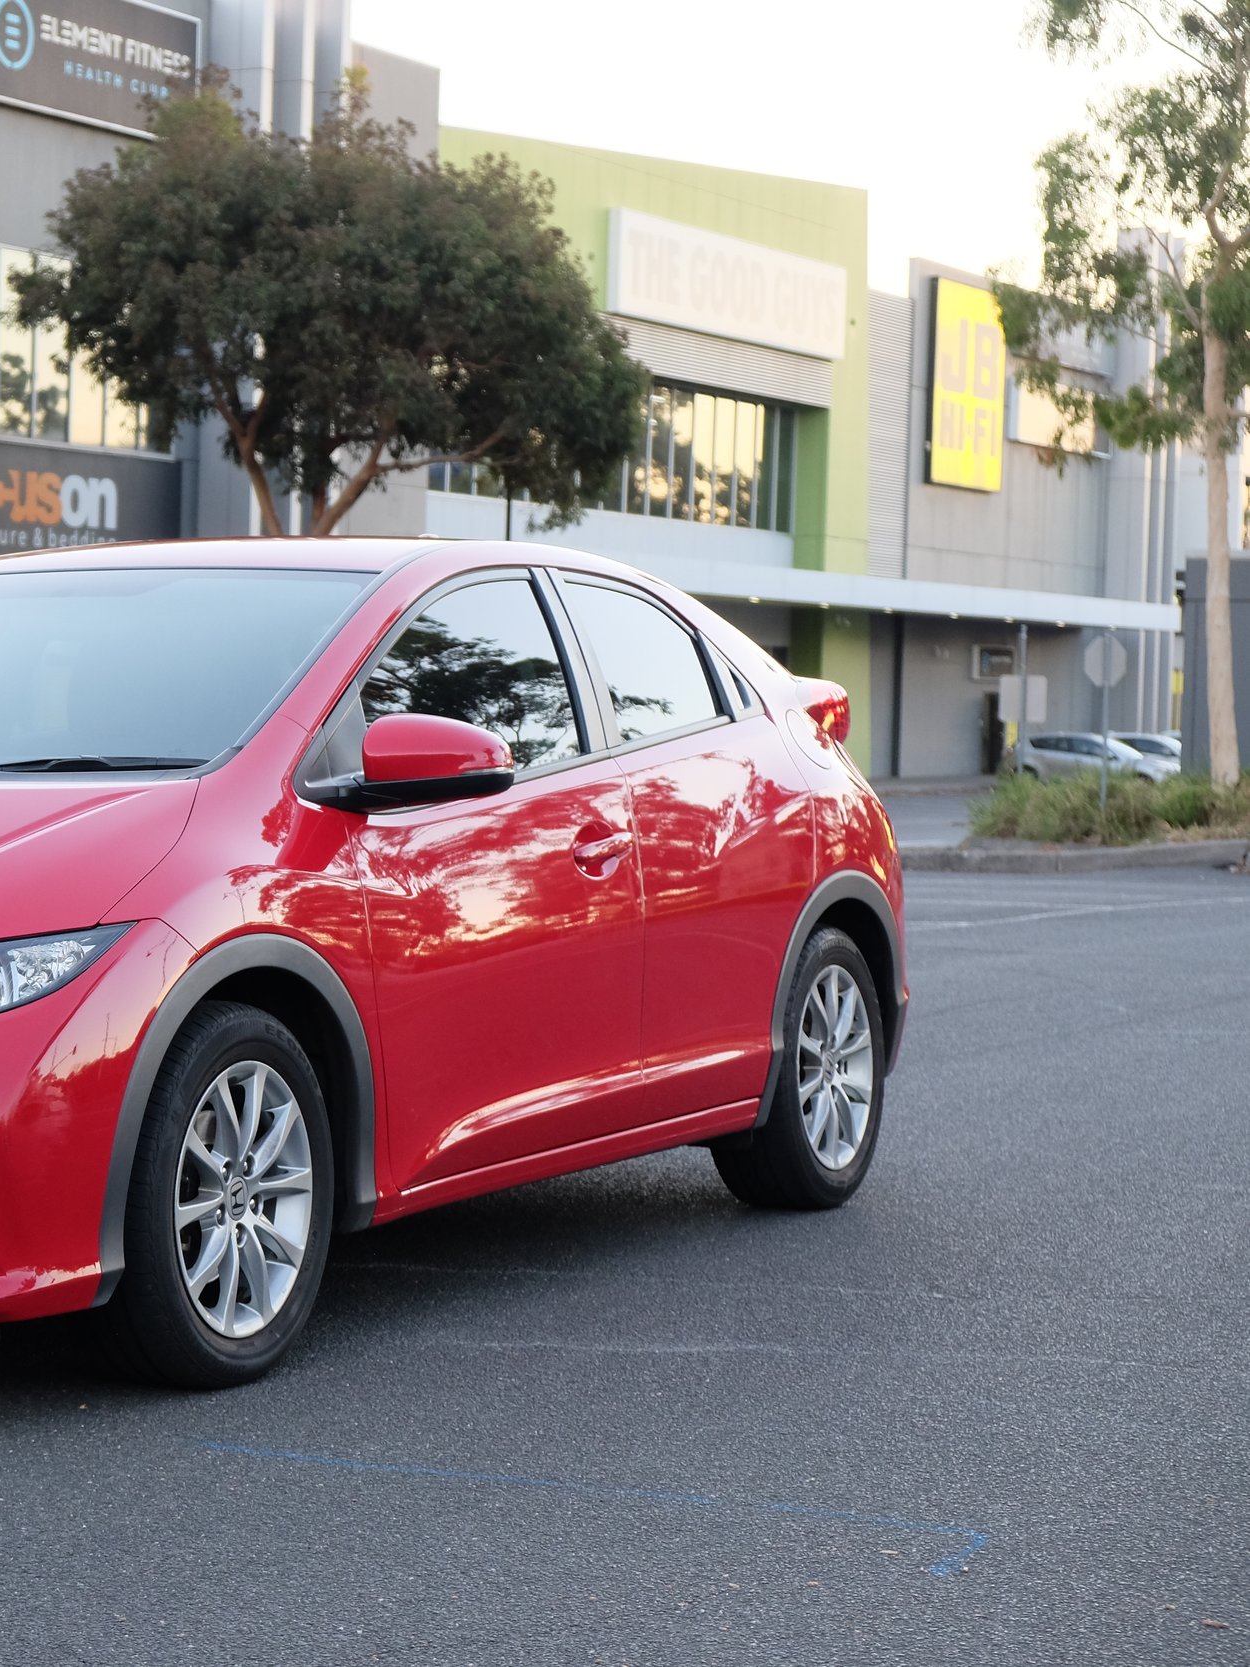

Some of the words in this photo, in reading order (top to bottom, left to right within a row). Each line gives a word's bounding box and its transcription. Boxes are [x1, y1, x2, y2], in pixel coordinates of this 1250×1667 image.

[40, 13, 123, 61] ELEMENT
[125, 38, 191, 80] FITNESS
[63, 59, 124, 89] HEALTH
[628, 228, 681, 305] THE
[689, 243, 767, 324] GOOD
[940, 317, 1001, 401] JB
[33, 527, 43, 548] &
